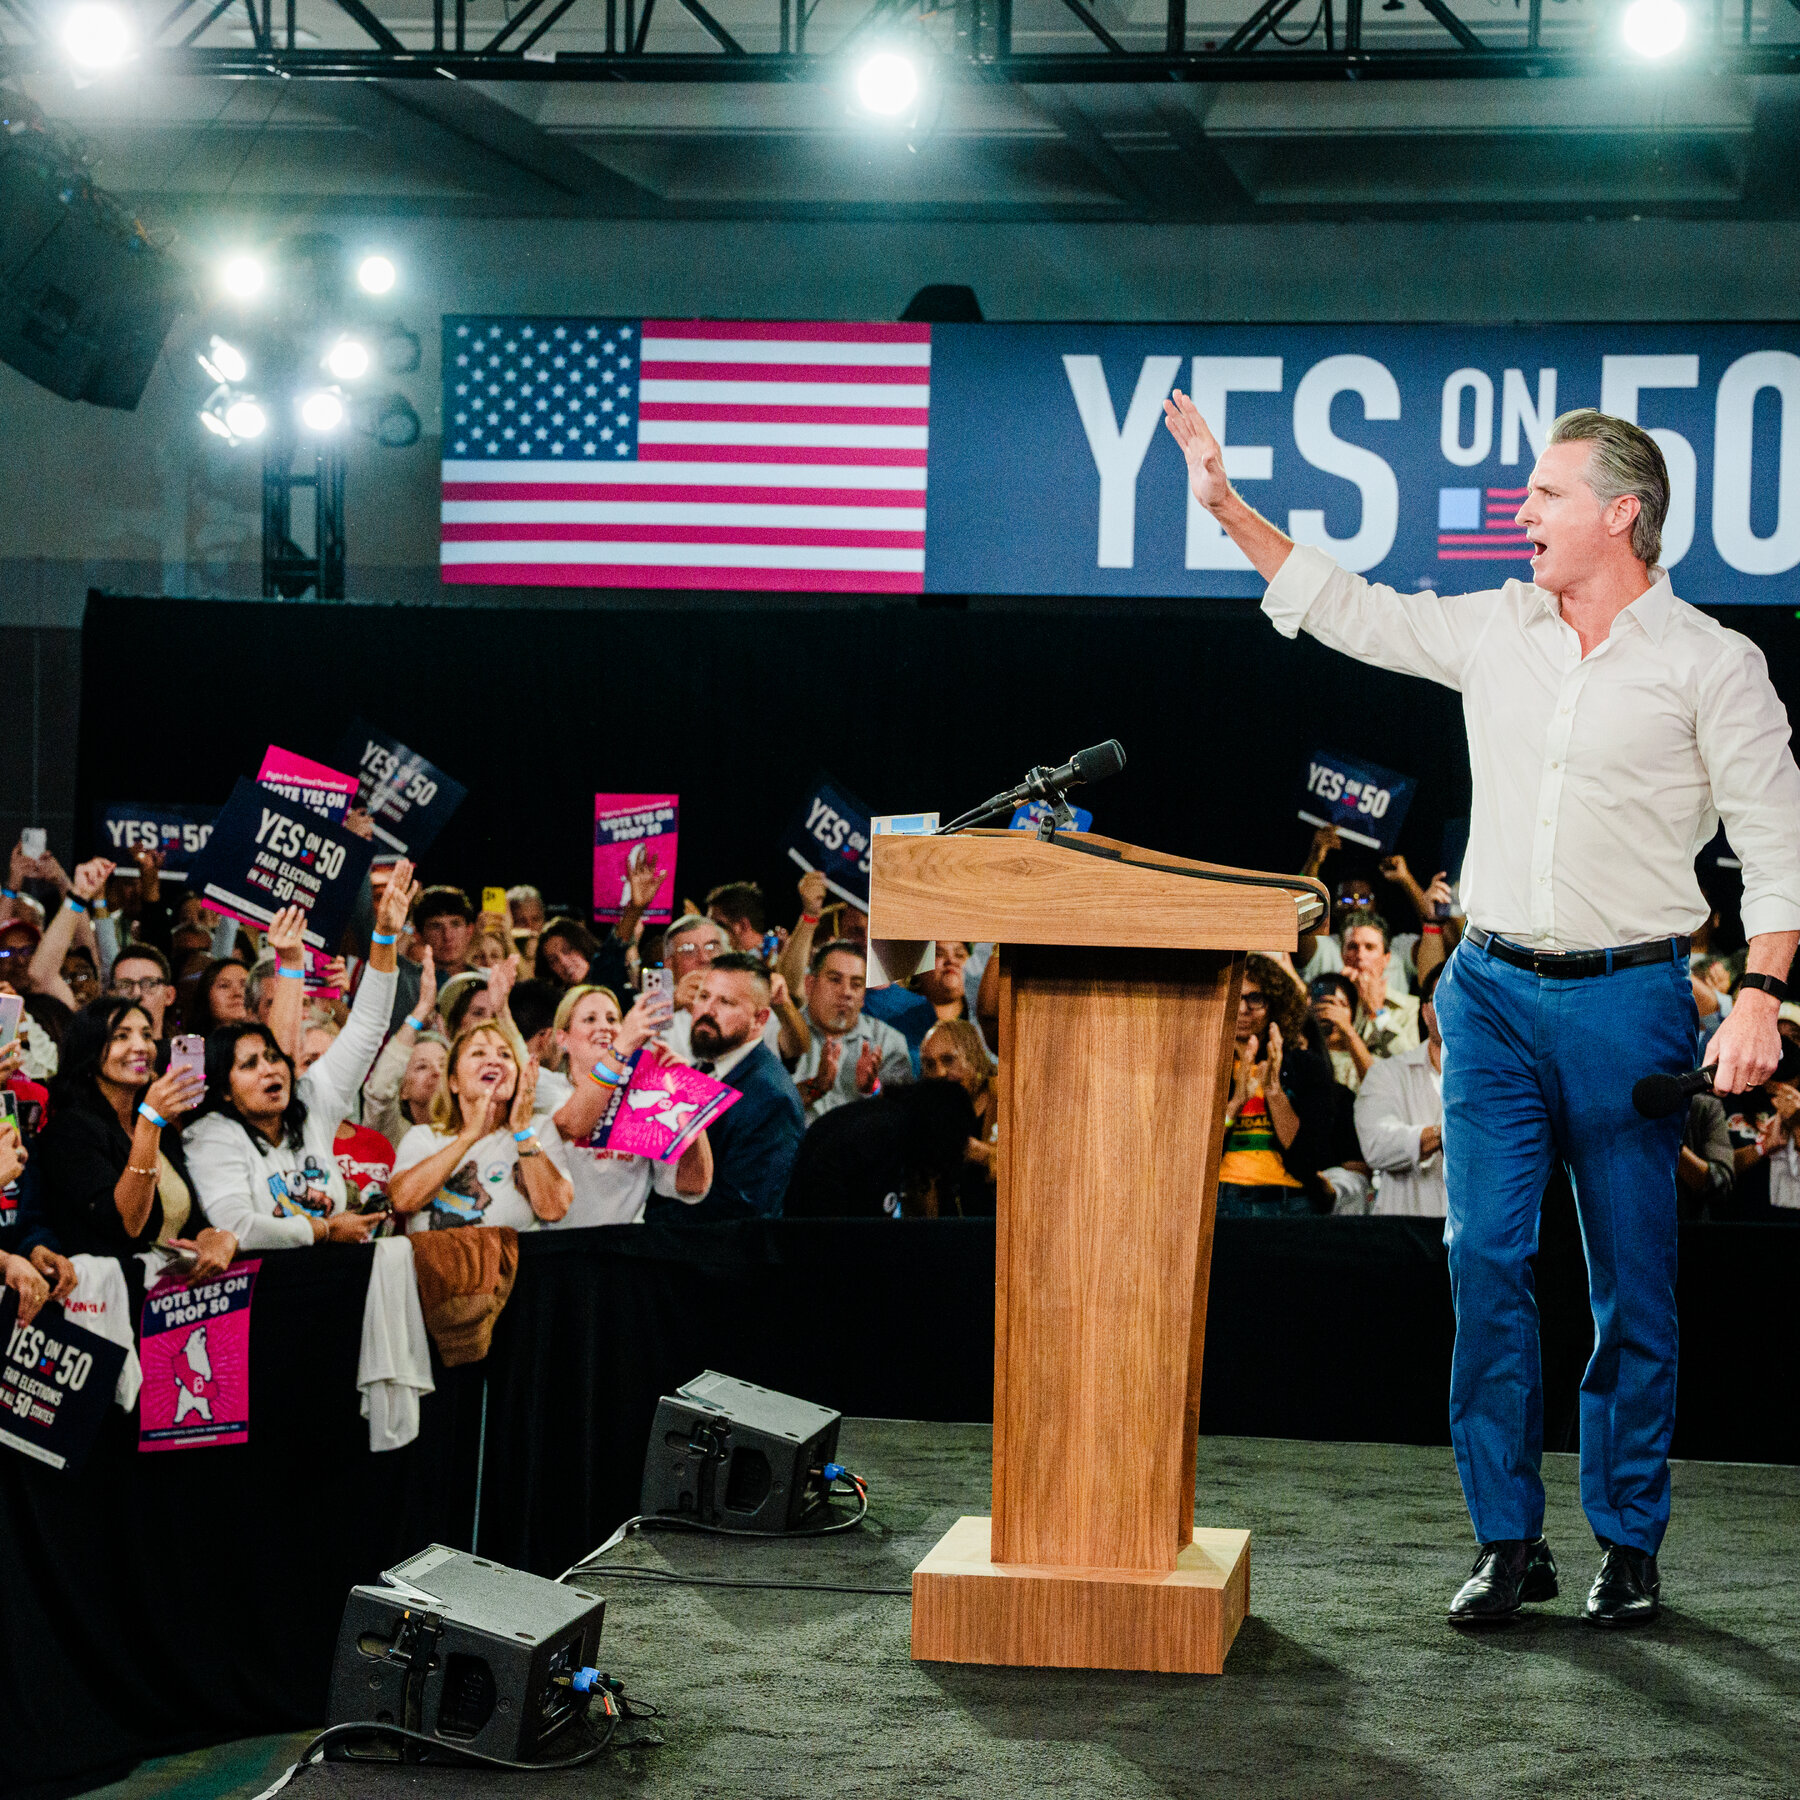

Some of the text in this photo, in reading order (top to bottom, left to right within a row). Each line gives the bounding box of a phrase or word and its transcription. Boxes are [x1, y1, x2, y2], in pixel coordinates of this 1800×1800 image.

[1061, 350, 1800, 575] YES ON 50
[360, 740, 400, 782] YES
[405, 773, 438, 807] 50
[1307, 762, 1346, 802] YES
[1357, 784, 1391, 819] 50
[302, 787, 326, 807] YES
[326, 792, 347, 809] ON
[106, 819, 159, 850] YES
[600, 815, 633, 832] VOTE
[632, 811, 655, 826] YES
[655, 807, 674, 822] ON
[804, 797, 851, 850] YES
[254, 807, 347, 881] YES ON 50
[254, 851, 322, 894] FAIR ELECTIONS
[258, 873, 275, 891] ALL
[272, 876, 296, 902] 50
[603, 1086, 625, 1127] PROP
[150, 1290, 191, 1315] VOTE
[193, 1283, 221, 1302] YES
[223, 1276, 248, 1294] ON
[165, 1295, 229, 1328] PROP 50
[5, 1318, 93, 1391] YES ON 50
[3, 1365, 64, 1407] FAIR ELECTIONS
[12, 1391, 33, 1418] 50
